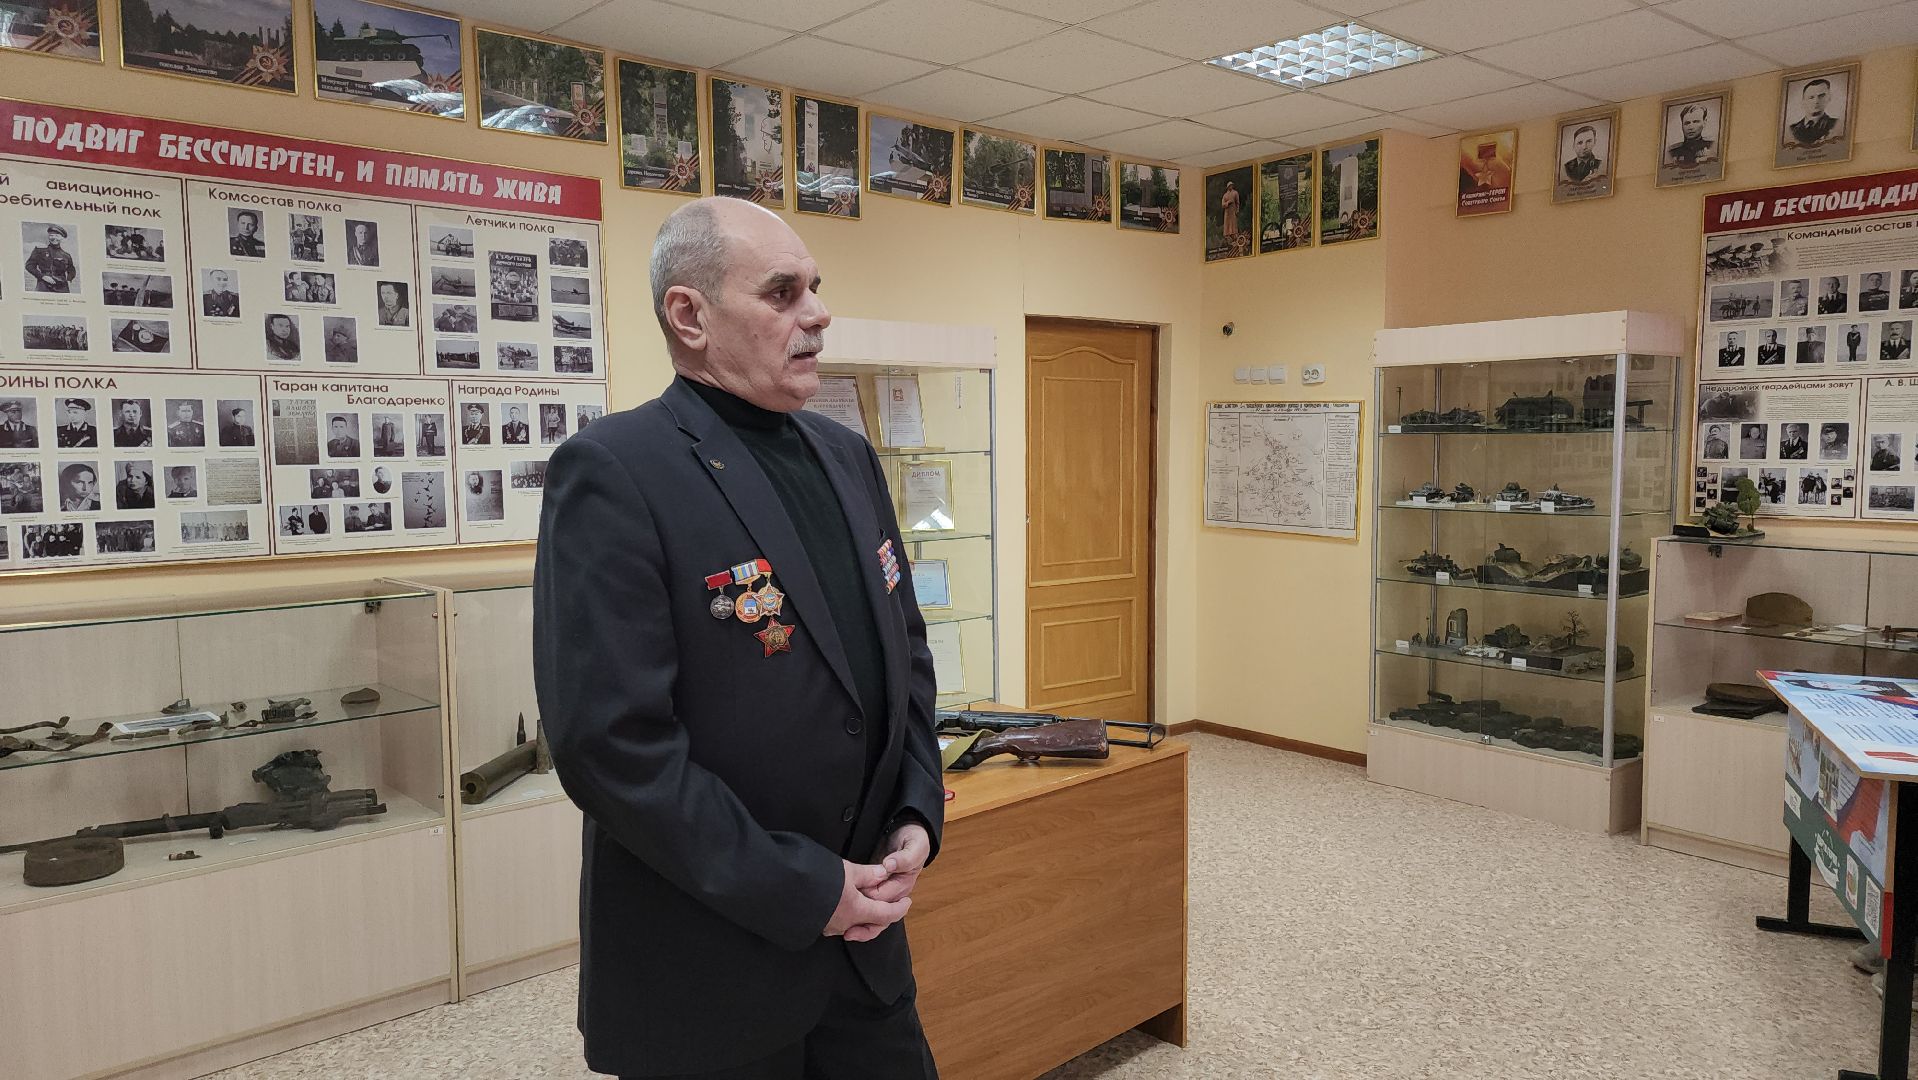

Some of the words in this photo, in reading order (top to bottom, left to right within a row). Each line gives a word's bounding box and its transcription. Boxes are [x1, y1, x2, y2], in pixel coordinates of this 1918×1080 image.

[12, 114, 145, 153] ПОДВИГ
[158, 133, 345, 183] БЕССМЕРТЕН,
[356, 159, 375, 183] И
[385, 163, 485, 197] ПАМЯТЬ
[493, 176, 562, 205] ЖИВА
[46, 180, 160, 201] авиационно-
[208, 187, 294, 208] Комсостав
[298, 199, 342, 213] полка
[121, 205, 162, 219] полк
[1719, 200, 1765, 224] Мы
[466, 214, 516, 231] Летчики
[519, 222, 555, 234] полка
[1787, 224, 1862, 240] Командный
[1865, 221, 1912, 233] состав
[55, 376, 117, 390] ПОЛКА
[273, 380, 318, 393] Таран
[321, 383, 389, 394] капитана
[1705, 384, 1747, 393] Недаром
[1761, 382, 1826, 391] гвардейцами
[1828, 381, 1854, 389] зовут
[458, 384, 512, 398] Награда
[514, 385, 560, 398] Родины
[346, 393, 446, 407] Благодаренко
[911, 470, 941, 478] ДИПЛОМ
